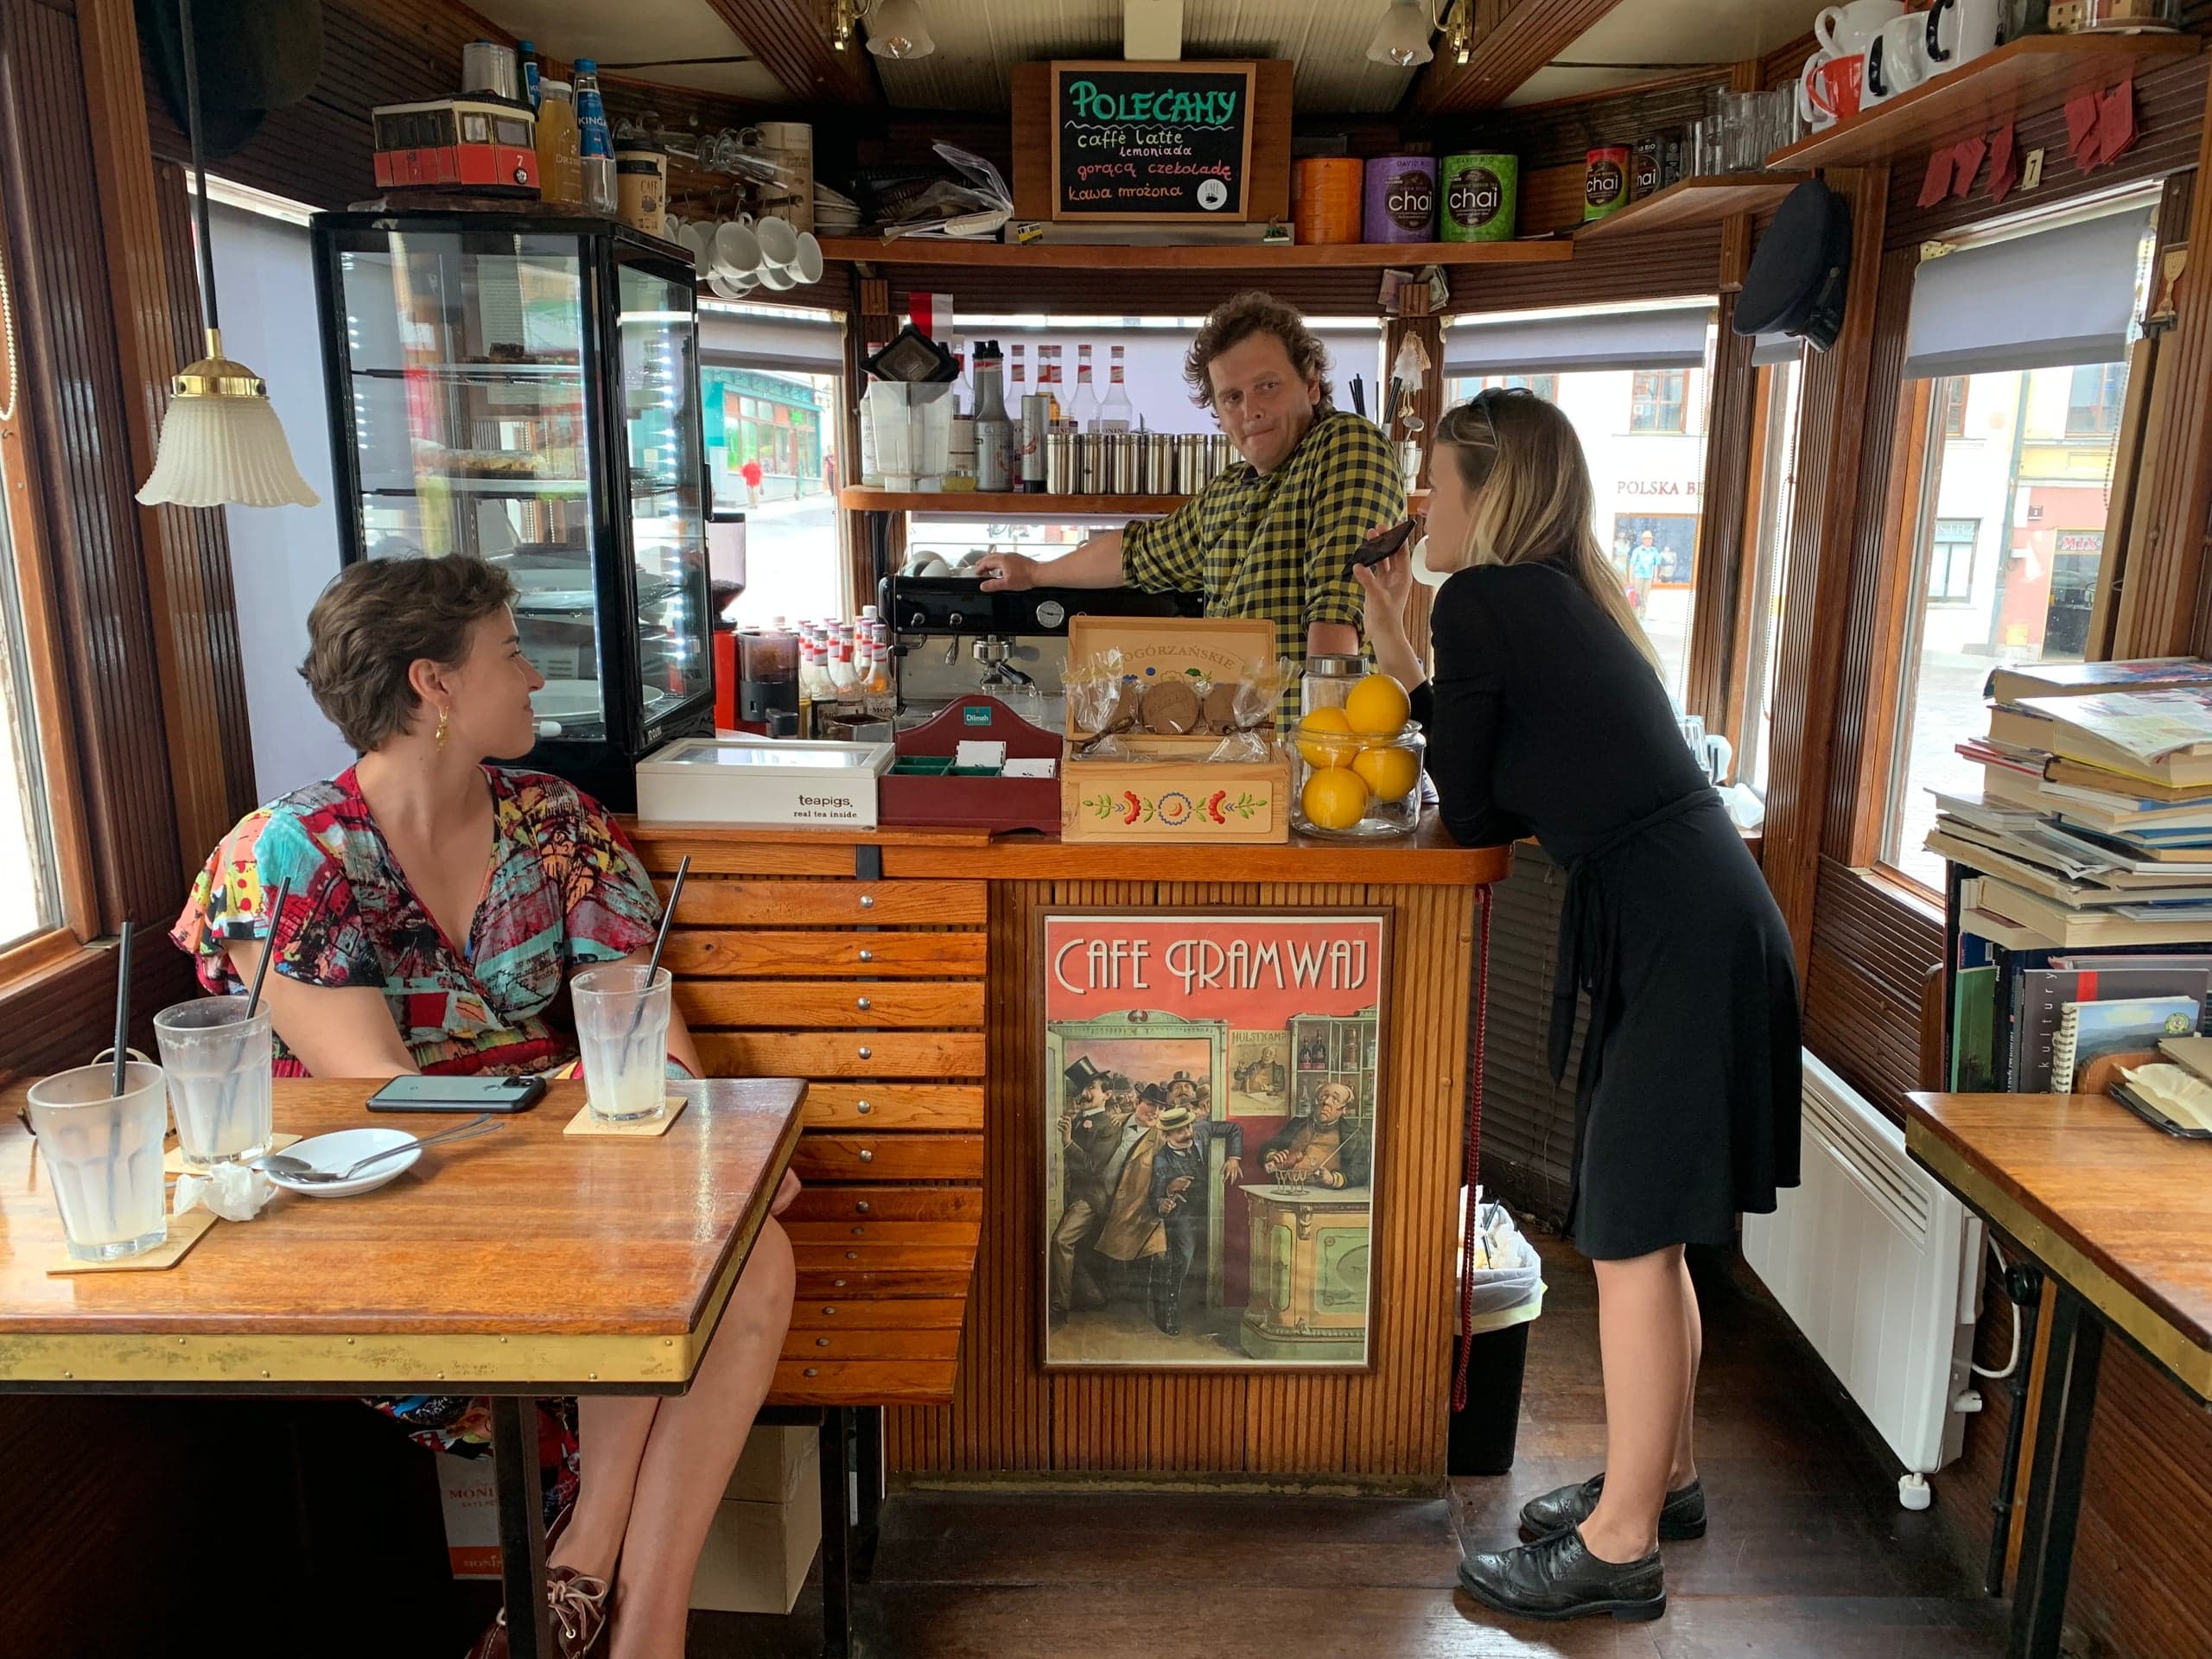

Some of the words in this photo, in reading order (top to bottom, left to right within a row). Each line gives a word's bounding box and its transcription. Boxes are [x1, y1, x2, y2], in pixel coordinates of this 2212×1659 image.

[1069, 80, 1236, 124] POLECAMY
[1077, 130, 1127, 149] caffè
[1135, 130, 1184, 144] latte
[1119, 145, 1192, 157] lemoniada
[517, 155, 524, 167] 7
[1077, 162, 1136, 180] gorącą
[1148, 159, 1232, 181] czekoladę
[2031, 159, 2037, 181] 7
[1586, 175, 1618, 192] chai
[1637, 168, 1656, 188] hai
[1069, 185, 1113, 200] kawa
[1118, 182, 1183, 197] mrożona
[1450, 187, 1497, 209] chai
[1389, 191, 1432, 211] chai
[1618, 481, 1679, 495] POLSKA
[1123, 644, 1236, 671] OGÓRZAŃSKIE
[798, 795, 853, 808] teapigs.
[1054, 938, 1151, 995] CAFE
[1165, 938, 1368, 995] TRAMWAJ
[2038, 973, 2057, 1069] kultury
[1232, 1032, 1286, 1044] HULSTKAMP
[449, 1488, 496, 1499] MONI
